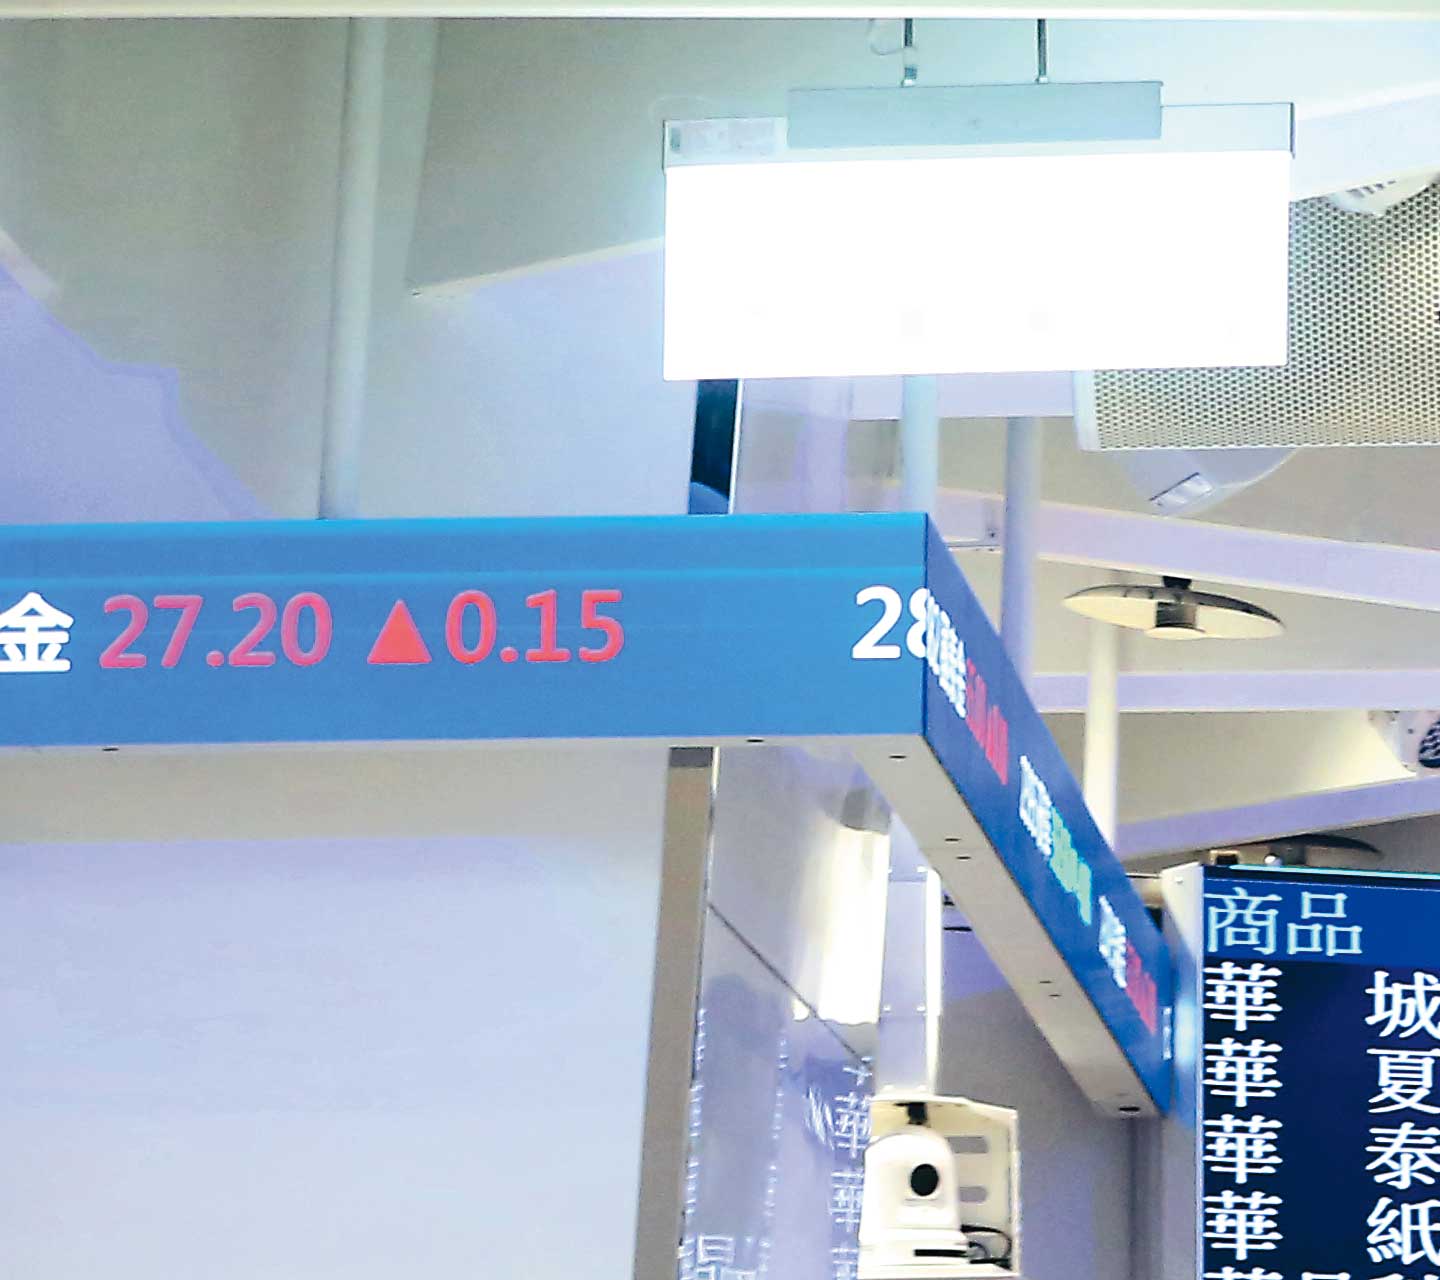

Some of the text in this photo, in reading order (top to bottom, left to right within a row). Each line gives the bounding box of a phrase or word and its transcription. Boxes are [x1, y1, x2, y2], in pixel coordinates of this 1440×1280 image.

[102, 595, 330, 667] 27.20
[447, 592, 622, 663] 0.15
[1197, 882, 1362, 965] 商品
